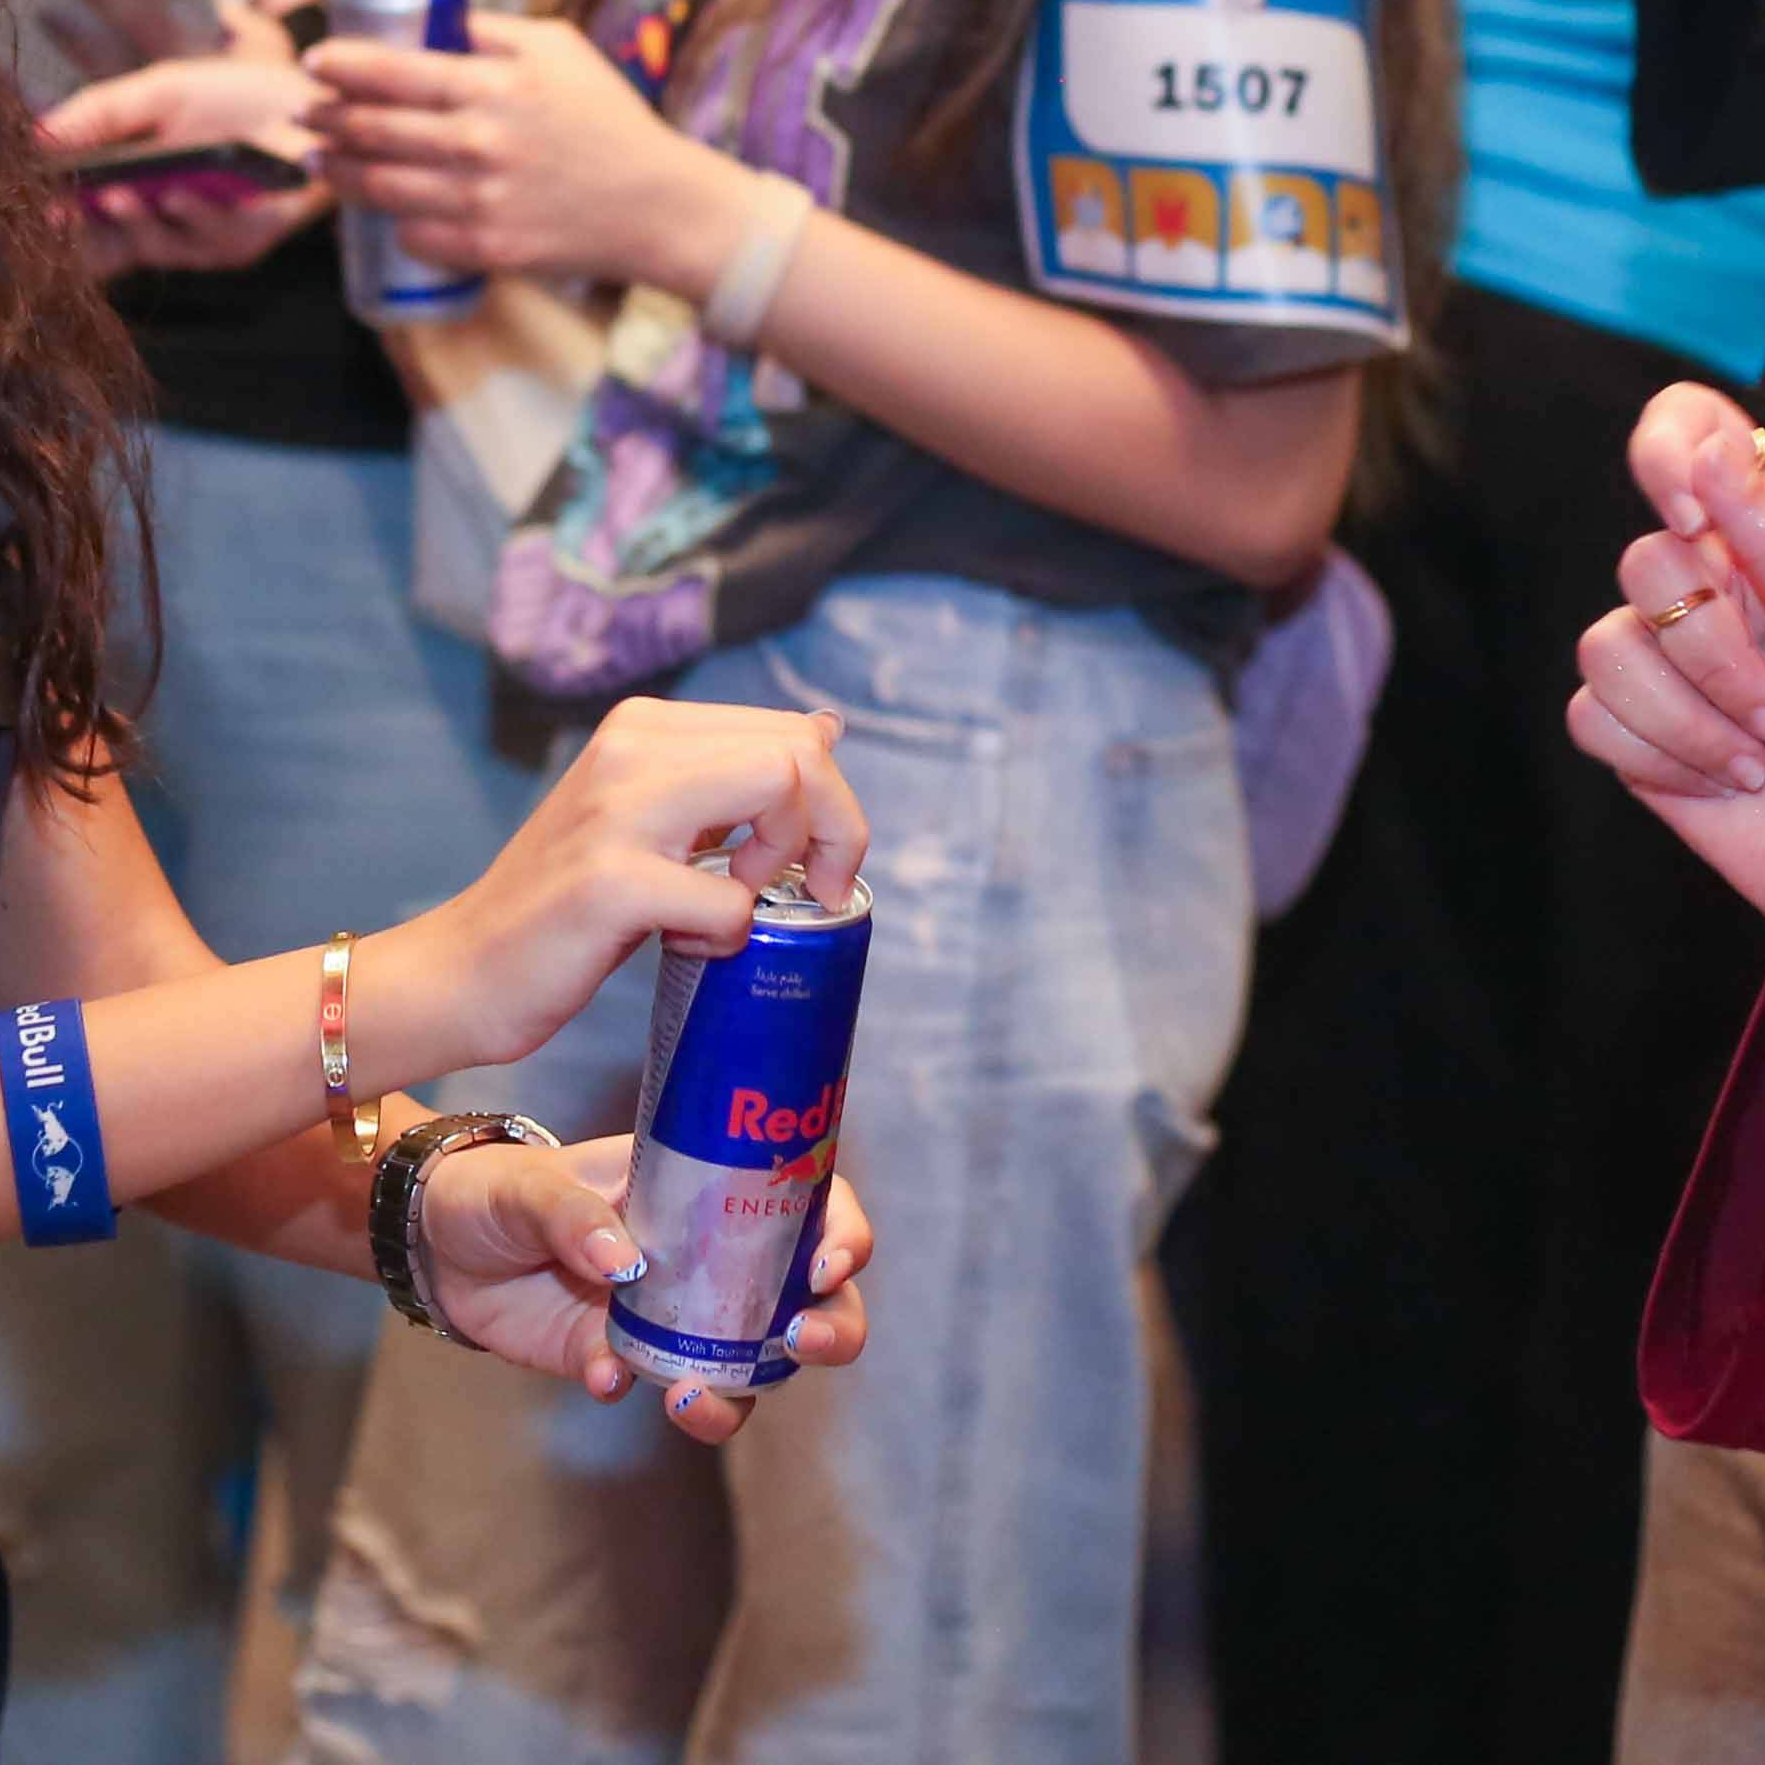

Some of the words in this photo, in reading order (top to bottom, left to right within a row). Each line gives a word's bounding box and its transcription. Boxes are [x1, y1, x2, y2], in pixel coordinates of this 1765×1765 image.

[1152, 61, 1310, 117] 1507
[15, 1002, 66, 1089] edBull
[727, 1084, 833, 1143] Red
[723, 1195, 808, 1217] ENERG
[677, 1337, 706, 1356] With
